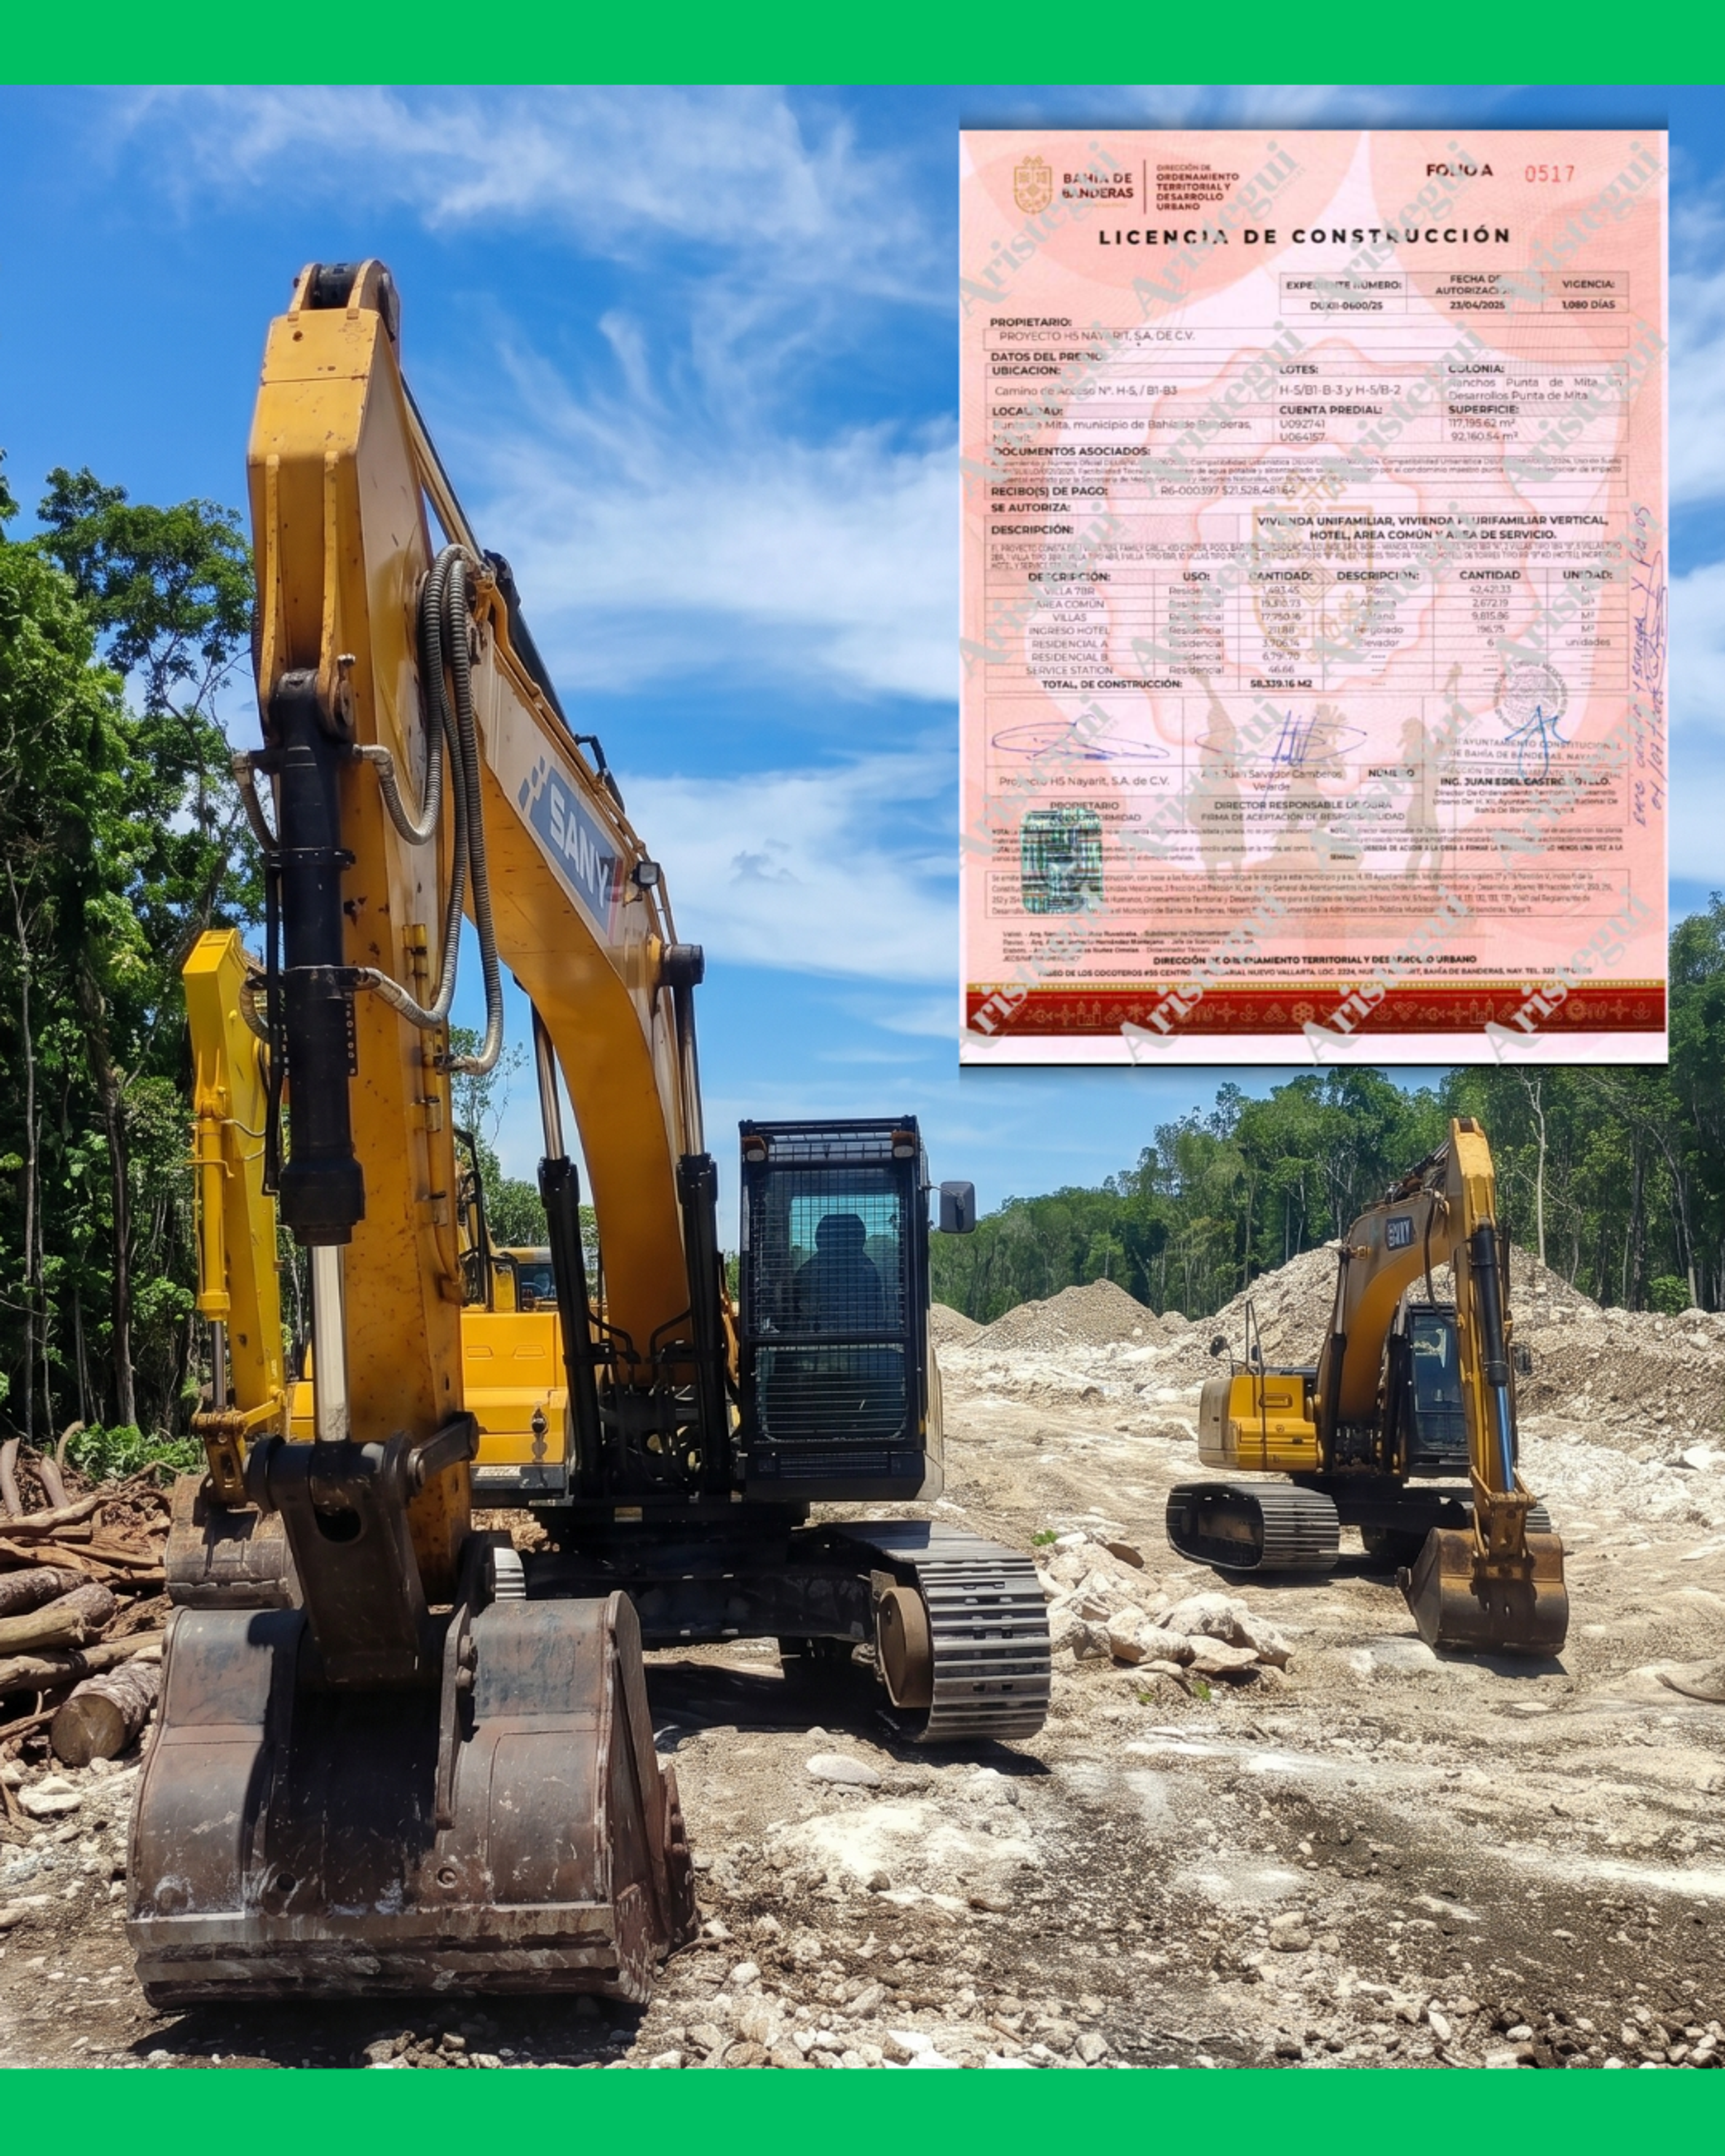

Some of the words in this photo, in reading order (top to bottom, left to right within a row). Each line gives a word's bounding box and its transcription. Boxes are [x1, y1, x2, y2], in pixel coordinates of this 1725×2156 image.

[1200, 162, 1211, 171] DE
[1481, 164, 1494, 177] A
[1157, 173, 1239, 181] ORDENAMIENTO
[1525, 165, 1575, 182] 0517
[1113, 173, 1132, 184] DE
[1157, 183, 1222, 191] TERRITORIAL
[1225, 183, 1231, 191] Y
[1157, 193, 1224, 201] DESARROLLO
[1244, 229, 1277, 244] DE
[1292, 225, 1510, 244] CONSTRUCCIÓN
[1451, 275, 1485, 283] FECHA
[1562, 281, 1616, 290] VIGENCIA:
[1450, 301, 1505, 309] 23/04/2025
[1591, 300, 1616, 309] DÍAS
[990, 318, 1072, 327] PROPIETARIO:
[1000, 331, 1061, 341] PROYECTO
[1156, 331, 1172, 341] DE
[1175, 331, 1195, 341] C.V.
[991, 352, 1031, 362] DATOS
[1034, 352, 1056, 362] DEL
[1279, 365, 1319, 374] LOTES:
[1506, 378, 1539, 387] Punta
[1549, 378, 1563, 387] de
[1574, 378, 1597, 387] Mita
[995, 386, 1038, 396] Camino
[1345, 385, 1353, 397] y
[1356, 385, 1402, 397] H-5/B-2
[1449, 391, 1508, 400] Desarrollos
[1512, 391, 1544, 400] Punta
[1547, 391, 1561, 400] de
[1564, 391, 1588, 400] Mita
[1279, 405, 1327, 415] CUENTA
[1330, 405, 1383, 415] PREDIAL:
[1448, 405, 1520, 415] SUPERFICIE:
[1045, 421, 1070, 432] Mita,
[1074, 421, 1128, 432] municipio
[1131, 421, 1145, 432] de
[1280, 420, 1325, 429] U092741
[1079, 447, 1151, 456] ASOCIADOS:
[991, 486, 1049, 497] RECIBO(S)
[1053, 486, 1068, 497] DE
[1071, 486, 1108, 497] PAGO:
[991, 503, 1005, 512] SE
[1008, 503, 1071, 512] AUTORIZA:
[1317, 517, 1395, 526] UNIFAMILIAR,
[1398, 517, 1455, 526] VIVIENDA
[1550, 517, 1610, 526] VERTICAL,
[991, 524, 1074, 535] DESCRIPCIÓN:
[1309, 529, 1351, 540] HOTEL,
[1353, 529, 1385, 540] AREA
[1388, 529, 1432, 540] COMÚN
[1481, 529, 1496, 540] DE
[1499, 529, 1557, 540] SERVICIO.
[1183, 572, 1210, 581] USO:
[1460, 570, 1522, 580] CANTIDAD
[1065, 598, 1105, 609] COMÚN
[1053, 613, 1087, 622] VILLAS
[1028, 627, 1075, 635] INGRESO
[1078, 627, 1110, 635] HOTEL
[1032, 640, 1097, 648] RESIDENCIAL
[1100, 640, 1109, 648] A
[1566, 637, 1611, 647] unidades
[1031, 653, 1097, 662] RESIDENCIAL
[1100, 653, 1108, 662] B
[1026, 666, 1069, 675] SERVICE
[1072, 666, 1113, 675] STATION
[1169, 666, 1224, 675] Residencial
[1042, 678, 1077, 689] TOTAL,
[1080, 678, 1095, 689] DE
[1097, 678, 1183, 689] CONSTRUCCIÓN:
[1297, 679, 1313, 689] M2
[1068, 776, 1109, 788] Nayarit,
[1133, 776, 1147, 788] de
[1150, 776, 1170, 788] C.V.
[1465, 778, 1493, 786] JUAN
[1495, 778, 1520, 786] EDEL
[1050, 802, 1119, 810] PROPIETARIO
[1214, 801, 1266, 809] DIRECTOR
[1269, 801, 1344, 809] RESPONSABLE
[1201, 812, 1230, 822] FIRMA
[1232, 812, 1244, 822] DE
[1246, 812, 1303, 822] ACEPTACIÓN
[550, 783, 609, 909] SANY
[1153, 956, 1206, 965] DIRECCIÓN
[1303, 956, 1362, 965] TERRITORIAL
[1364, 956, 1370, 965] Y
[1438, 956, 1477, 965] URBANO
[1095, 968, 1142, 977] COCOTEROS
[1160, 968, 1192, 977] CENTRO
